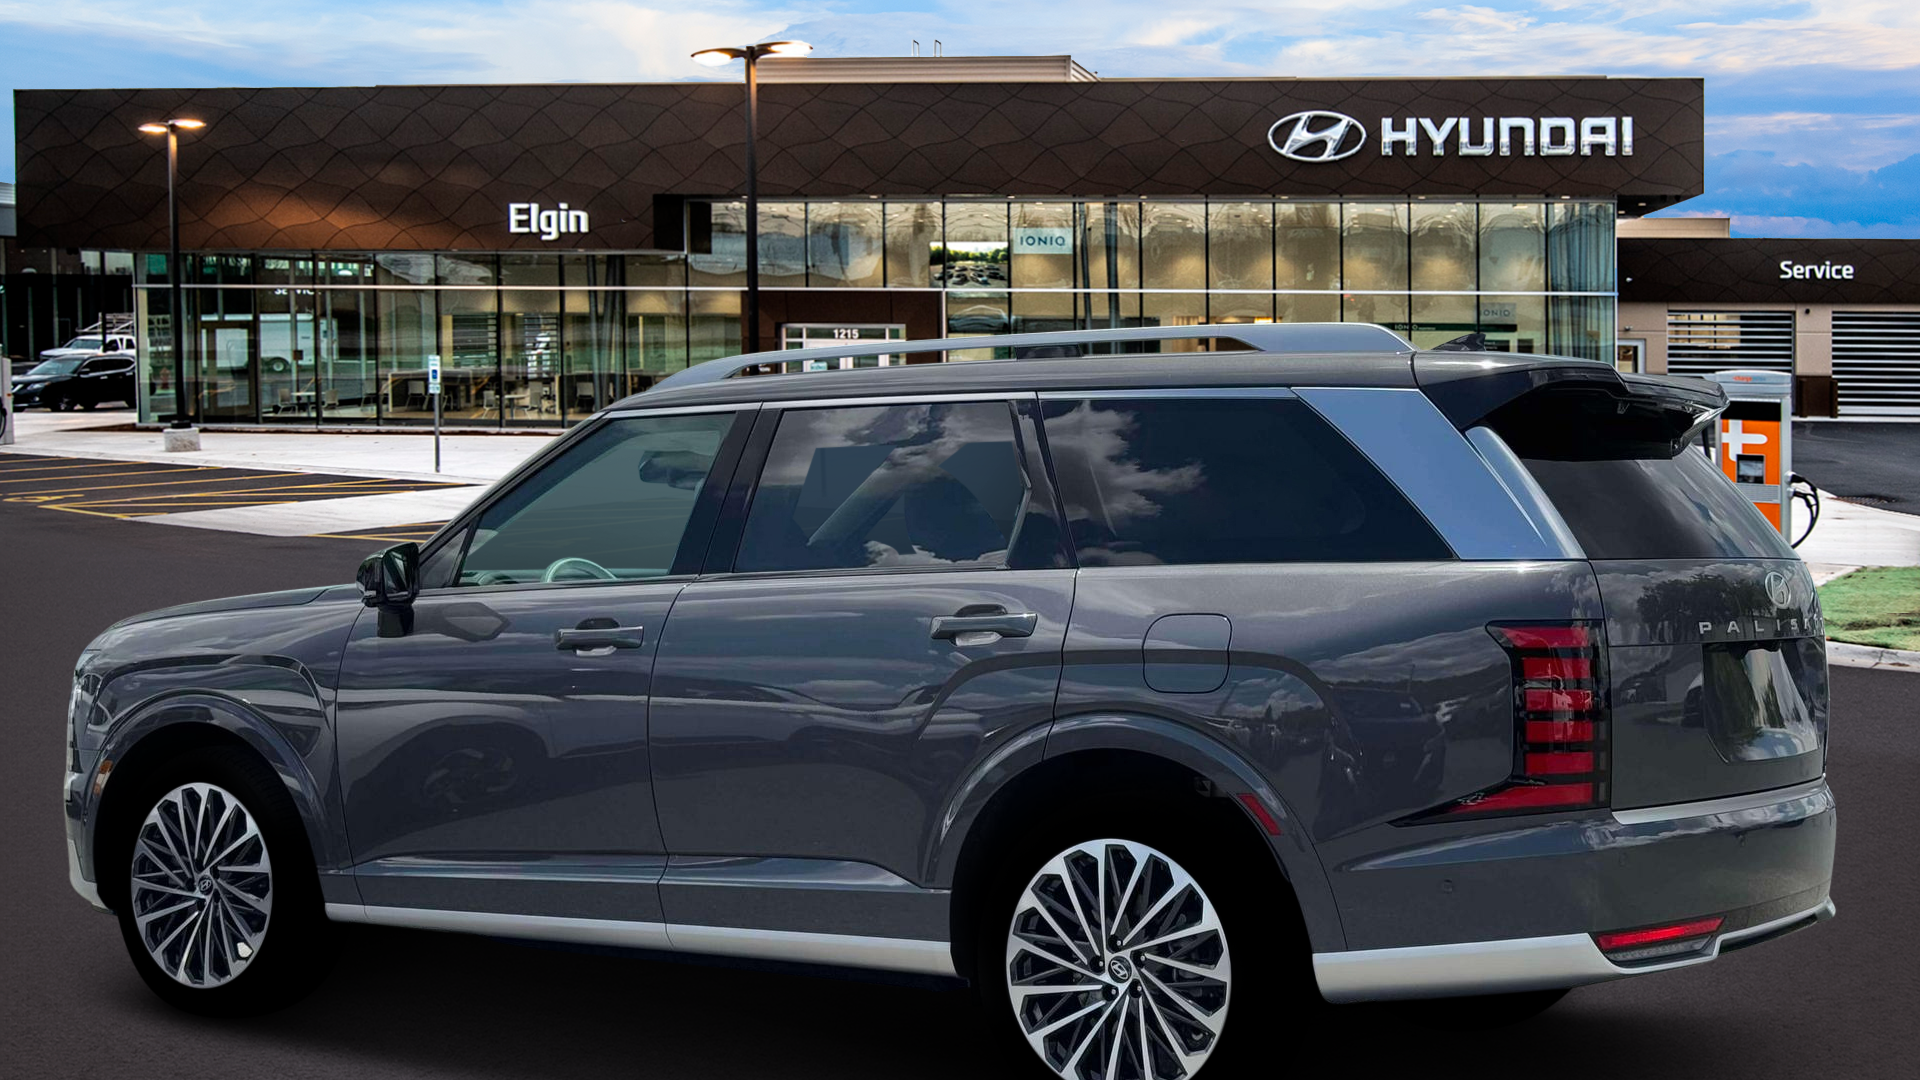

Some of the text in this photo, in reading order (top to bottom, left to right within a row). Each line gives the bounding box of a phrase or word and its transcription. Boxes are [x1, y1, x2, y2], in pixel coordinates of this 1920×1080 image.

[1381, 117, 1633, 156] HYUNDAI
[509, 203, 589, 240] Elgin
[1020, 235, 1065, 247] IONIQ
[1779, 260, 1855, 279] Service
[833, 328, 859, 339] 1215
